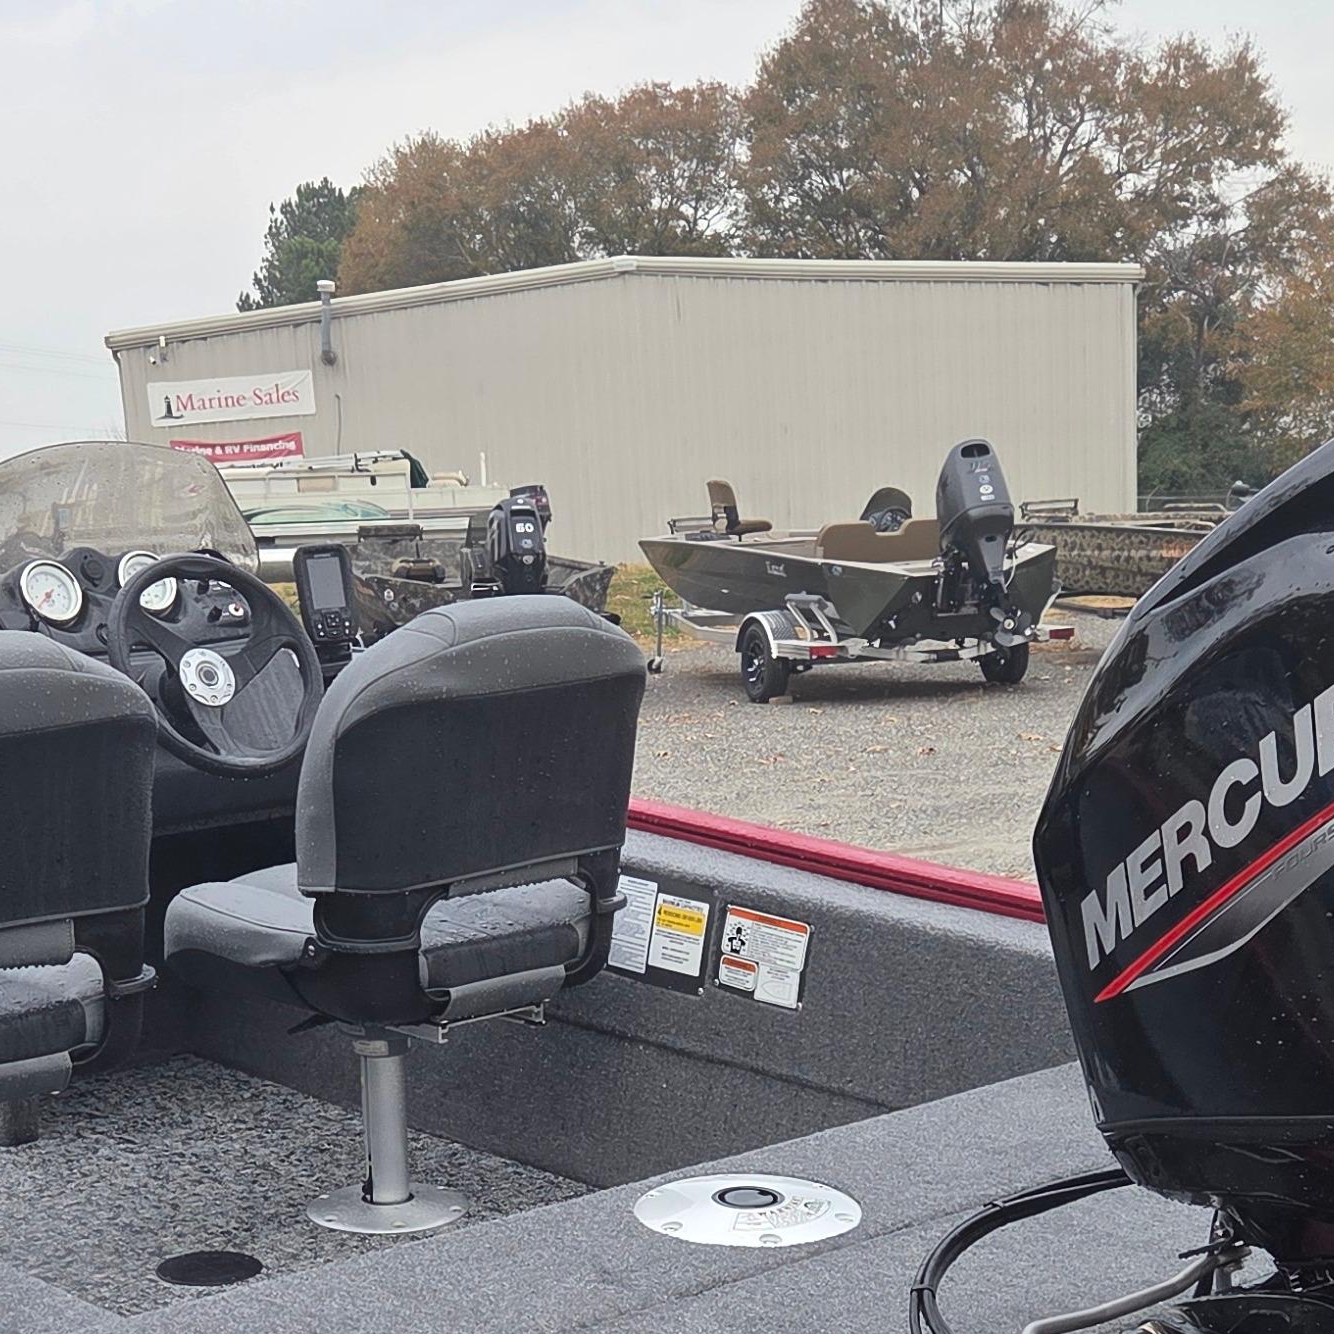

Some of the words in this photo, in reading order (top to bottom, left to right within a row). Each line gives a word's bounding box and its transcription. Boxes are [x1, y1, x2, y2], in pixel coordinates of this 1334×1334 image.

[175, 389, 247, 412] Marine
[252, 383, 300, 406] Sales
[215, 445, 223, 455] &
[225, 444, 241, 455] RV
[243, 439, 297, 453] Financing
